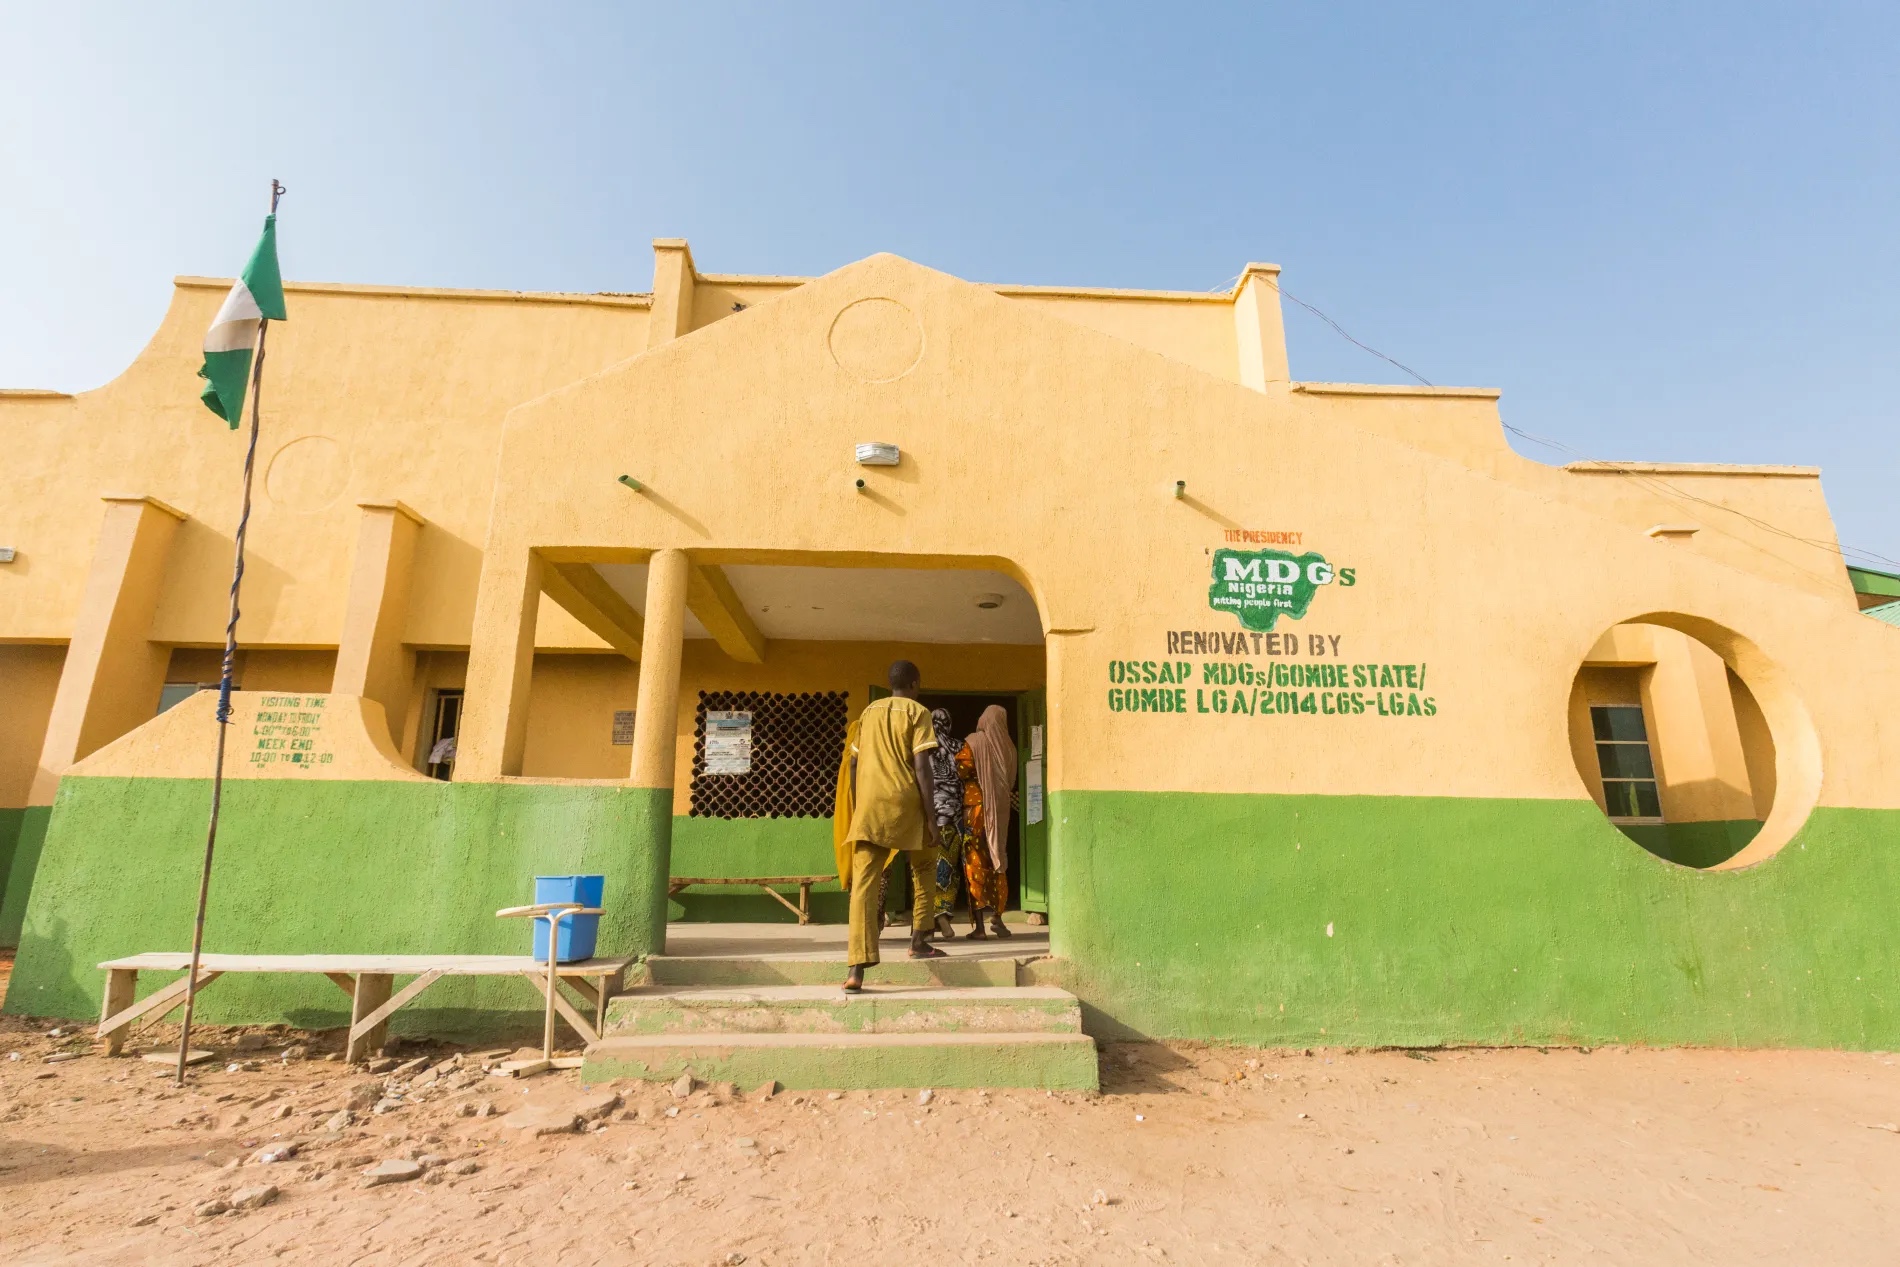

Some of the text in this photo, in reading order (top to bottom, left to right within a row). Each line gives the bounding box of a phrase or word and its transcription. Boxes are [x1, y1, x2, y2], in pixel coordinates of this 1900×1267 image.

[1224, 529, 1303, 545] THE PRESIDENCY
[1228, 582, 1293, 598] Nigeria
[1213, 596, 1292, 609] putting people first
[1167, 631, 1341, 657] RENOVATED BY
[1108, 660, 1192, 684] OSSAP
[261, 696, 326, 708] VISITING TIME
[1108, 688, 1187, 713] GOMBE
[256, 711, 287, 723] MONDAY
[290, 738, 313, 750] END
